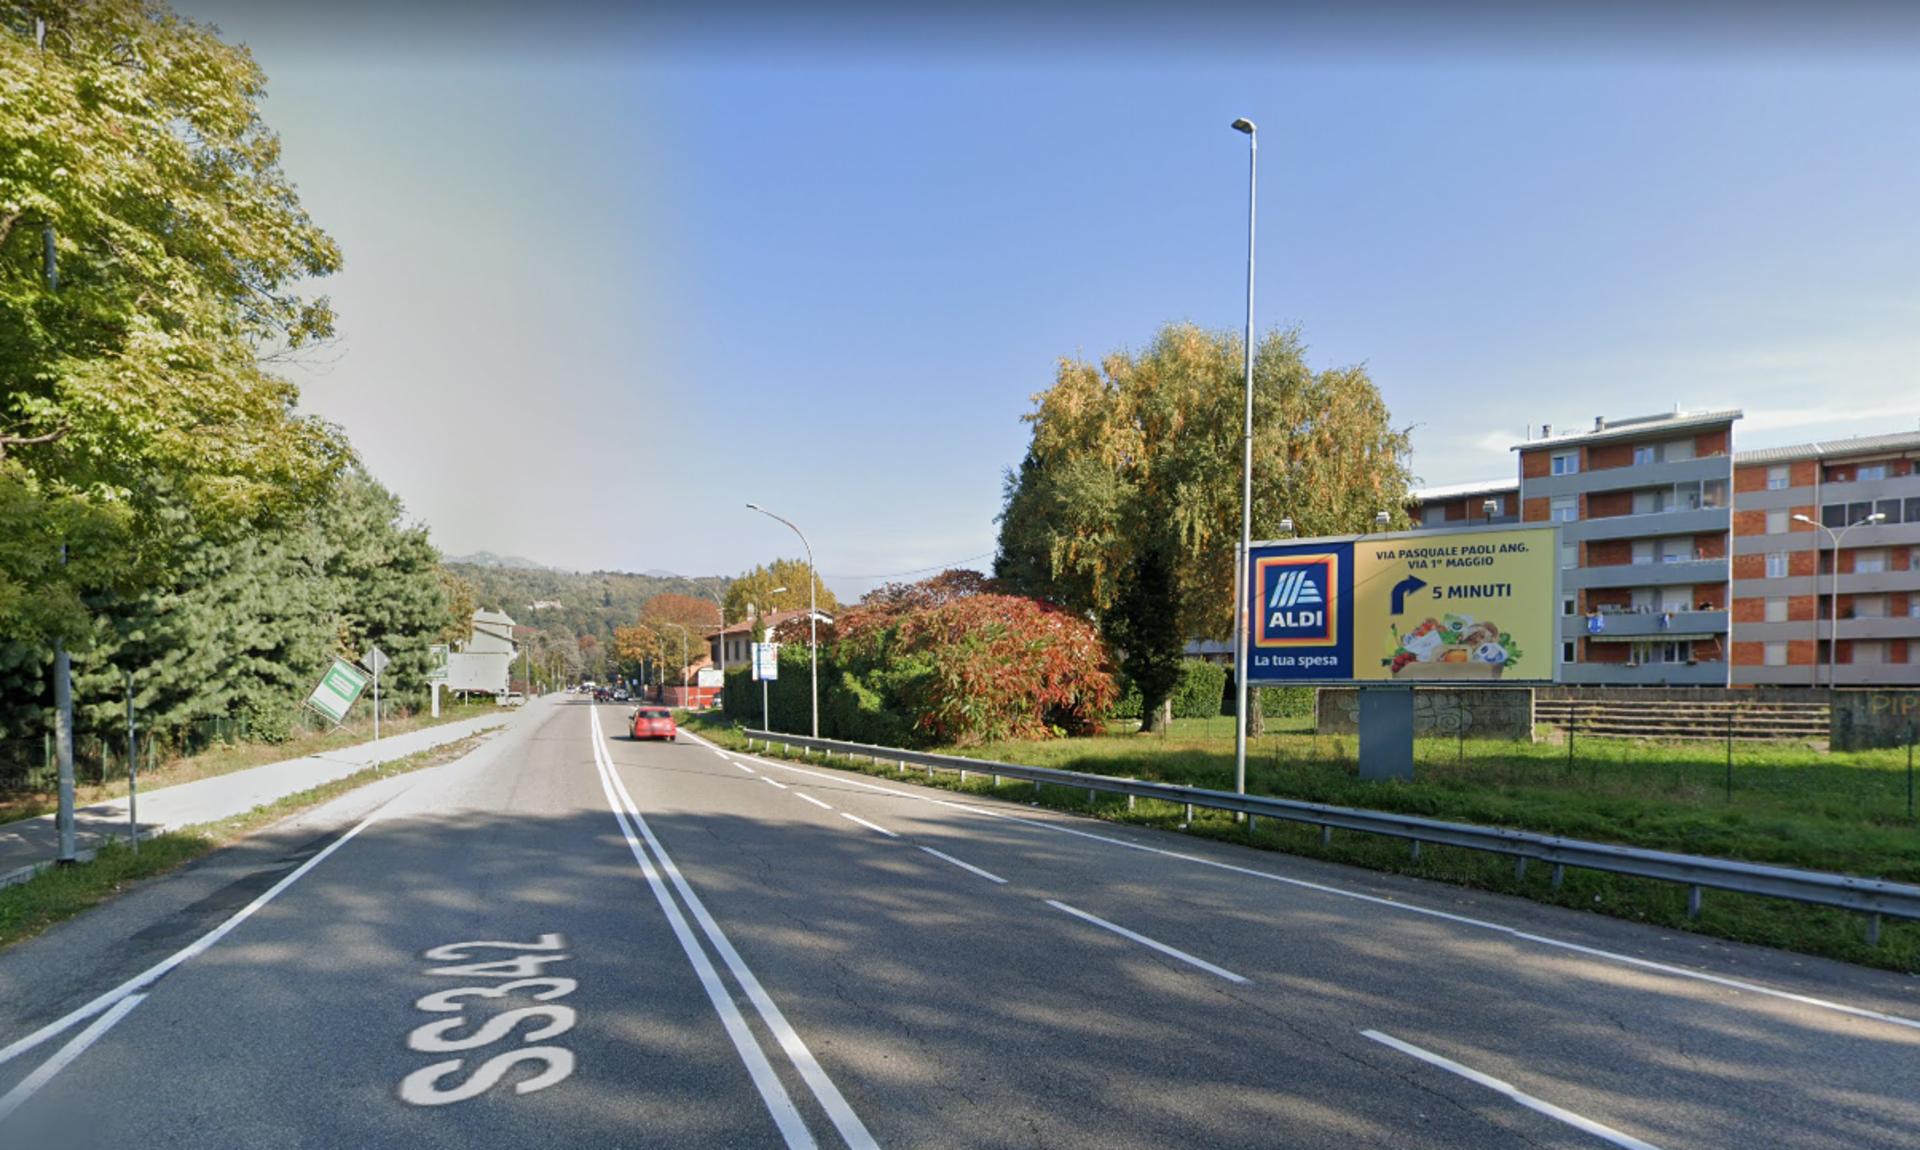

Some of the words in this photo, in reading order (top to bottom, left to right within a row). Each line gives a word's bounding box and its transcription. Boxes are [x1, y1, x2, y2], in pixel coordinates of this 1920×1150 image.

[1376, 551, 1395, 560] VIA
[1399, 547, 1459, 559] PASQUALE
[1461, 545, 1495, 555] PAOLI
[1499, 543, 1529, 553] ANG.
[1408, 560, 1428, 569] VIA
[1446, 557, 1494, 567] MAGGIO
[1432, 586, 1442, 599] 5
[1448, 583, 1511, 599] MINUTI
[1269, 611, 1323, 628] ALDI
[1254, 655, 1270, 666] La
[1272, 655, 1295, 666] tua
[1298, 656, 1338, 669] spesa
[399, 933, 579, 1106] SS342
